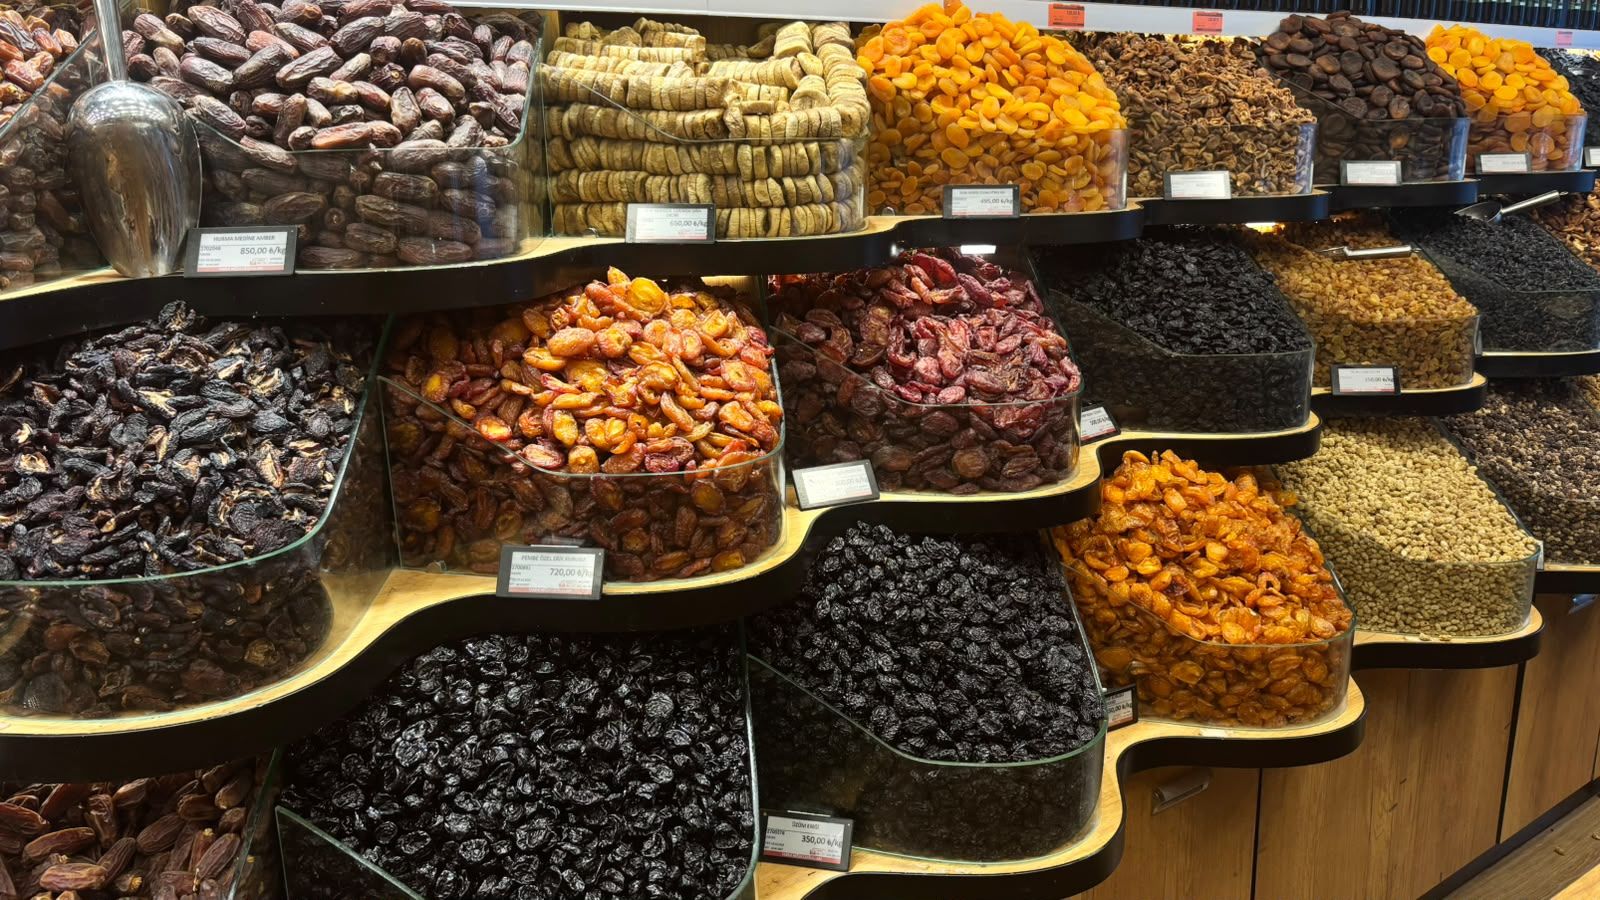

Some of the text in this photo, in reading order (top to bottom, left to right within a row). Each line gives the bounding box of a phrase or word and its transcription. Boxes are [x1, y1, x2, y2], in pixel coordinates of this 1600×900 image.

[240, 246, 267, 255] 850,00
[549, 567, 575, 577] 720,00
[801, 834, 826, 846] 350,00
